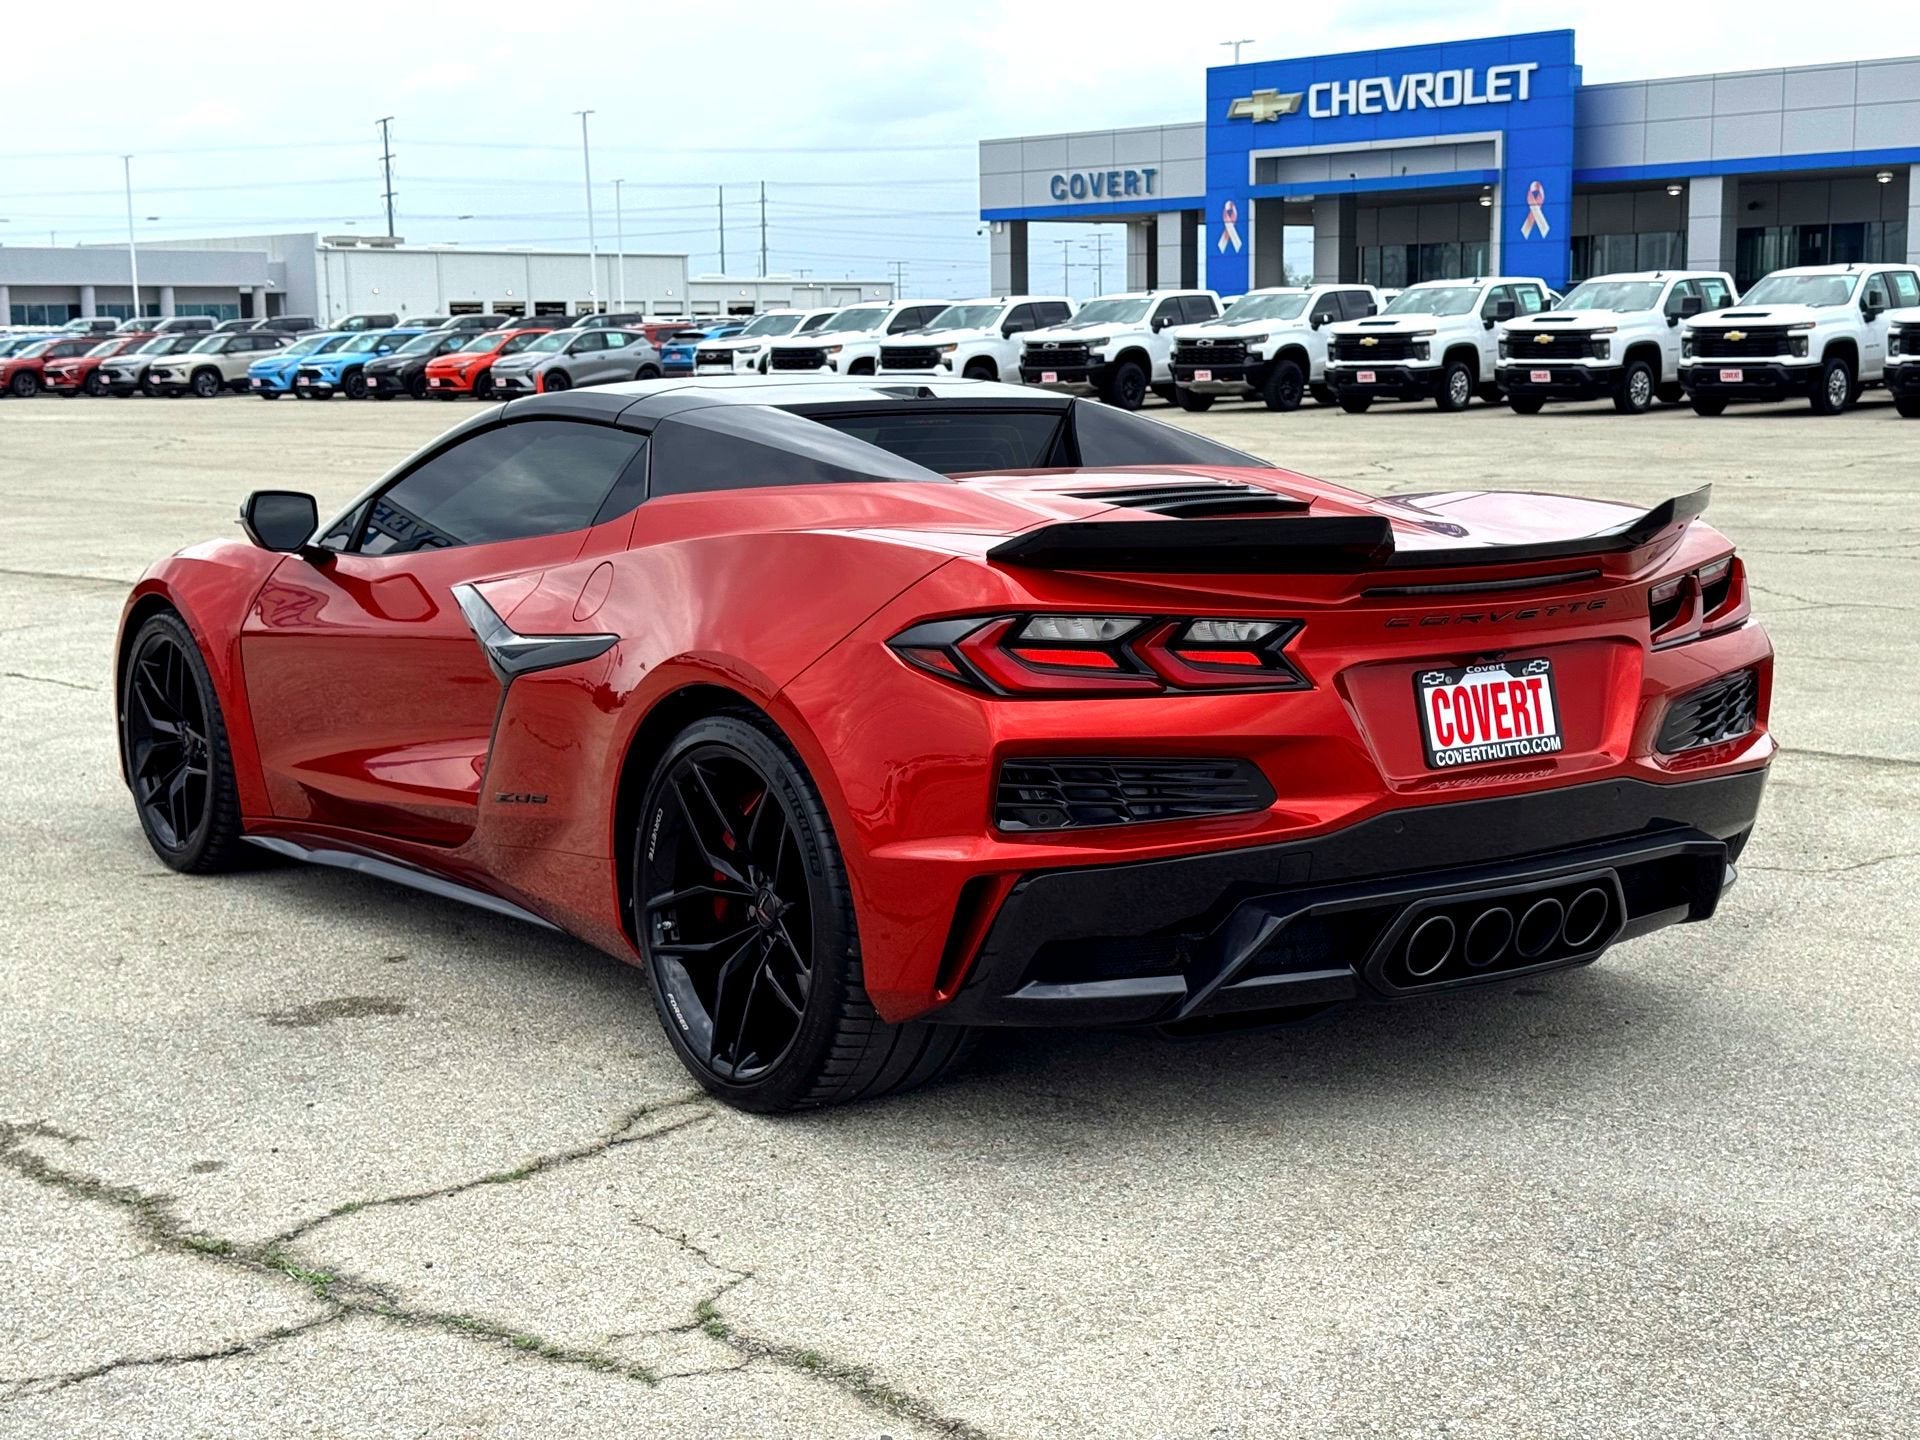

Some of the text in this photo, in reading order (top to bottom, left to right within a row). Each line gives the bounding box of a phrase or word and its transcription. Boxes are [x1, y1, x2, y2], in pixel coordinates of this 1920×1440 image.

[1308, 61, 1539, 119] CHEVROLET
[1050, 168, 1157, 201] COVERT
[1384, 599, 1607, 627] CORVETTE
[1465, 662, 1506, 674] Covert
[1431, 678, 1546, 748] COVERT
[1436, 736, 1562, 767] COVERTHUTTO.COM
[495, 792, 549, 804] Z06
[648, 808, 663, 862] CORVETTE
[667, 993, 690, 1031] FORGED
